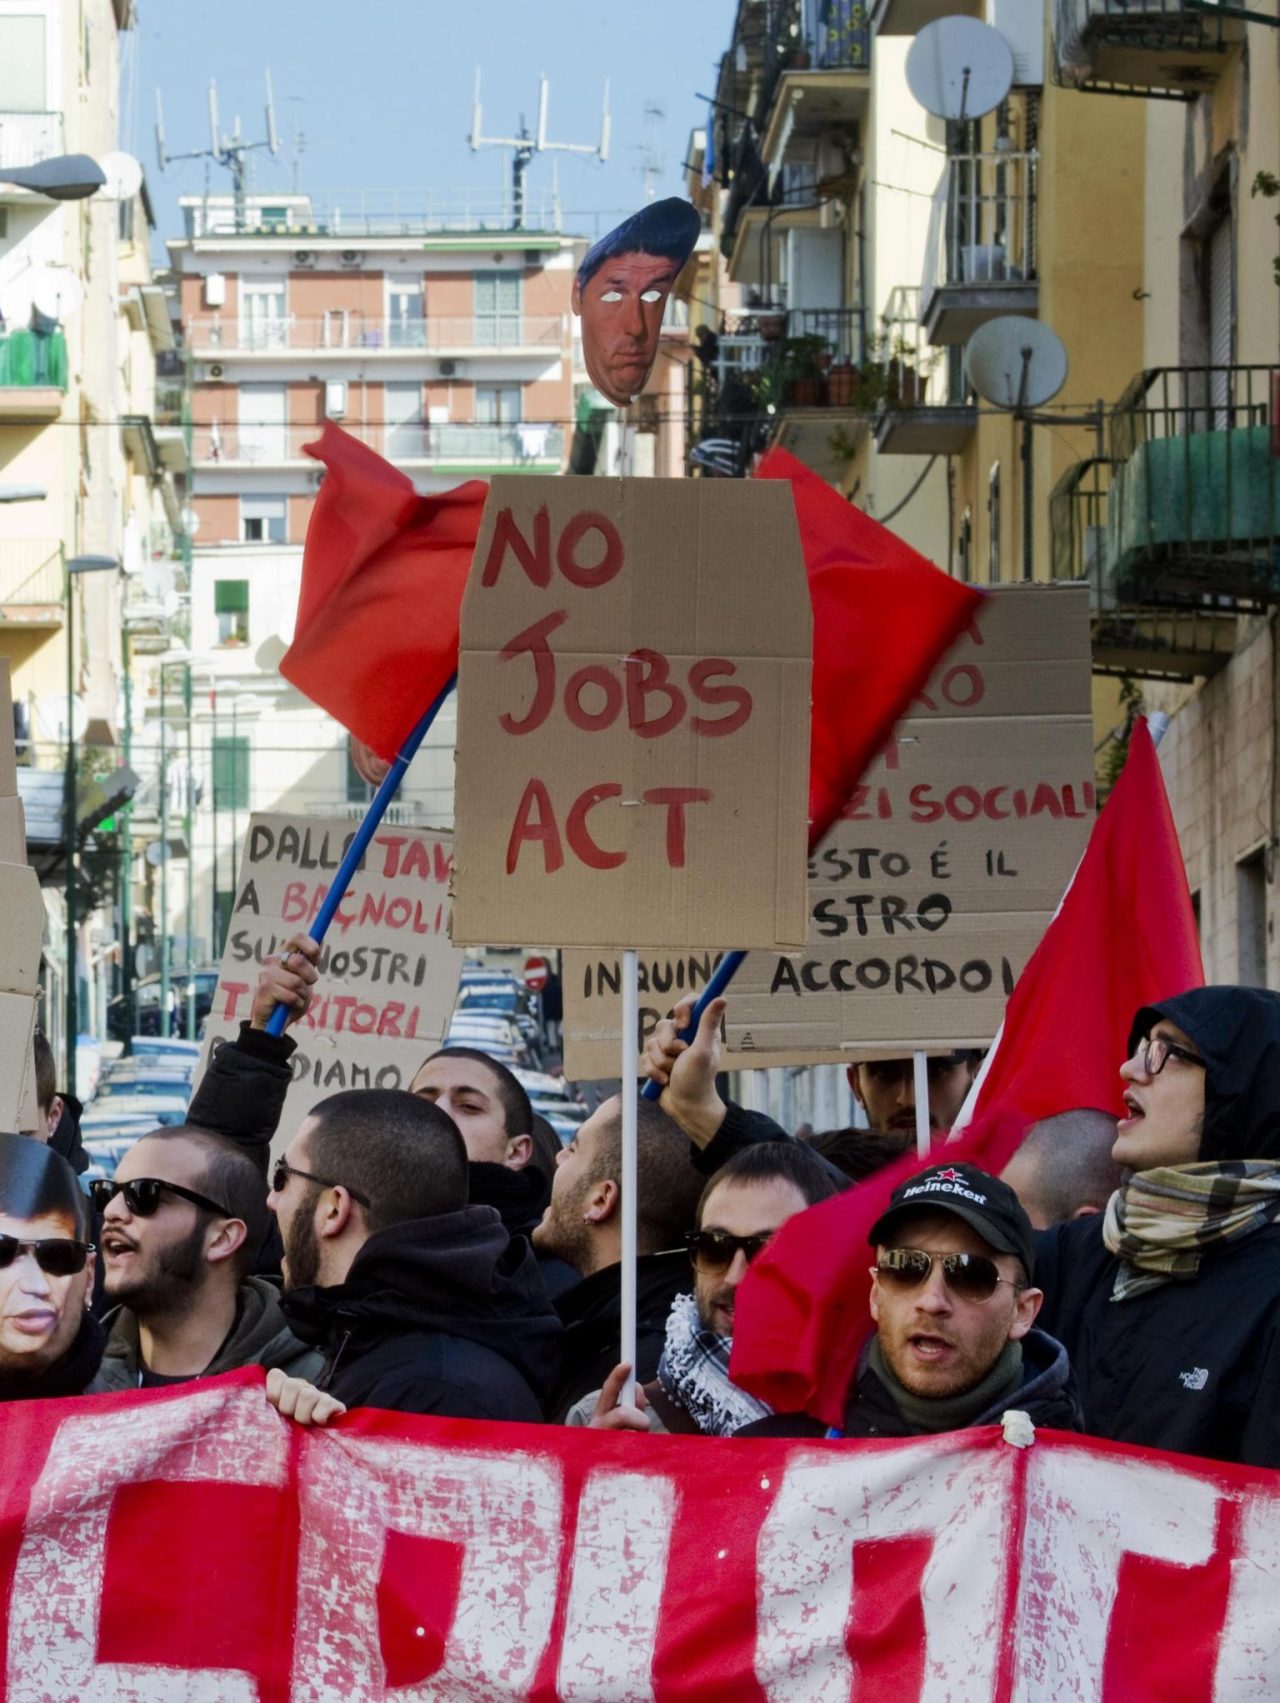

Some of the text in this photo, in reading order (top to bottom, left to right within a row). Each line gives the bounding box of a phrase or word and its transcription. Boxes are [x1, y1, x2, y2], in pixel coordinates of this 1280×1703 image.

[480, 503, 626, 589] NO
[497, 609, 754, 739] JOBS
[908, 780, 1096, 823] SOCIALI
[506, 777, 714, 875] ACT
[985, 848, 1018, 878] IL
[234, 879, 260, 916] A
[903, 1181, 988, 1206] Heineken
